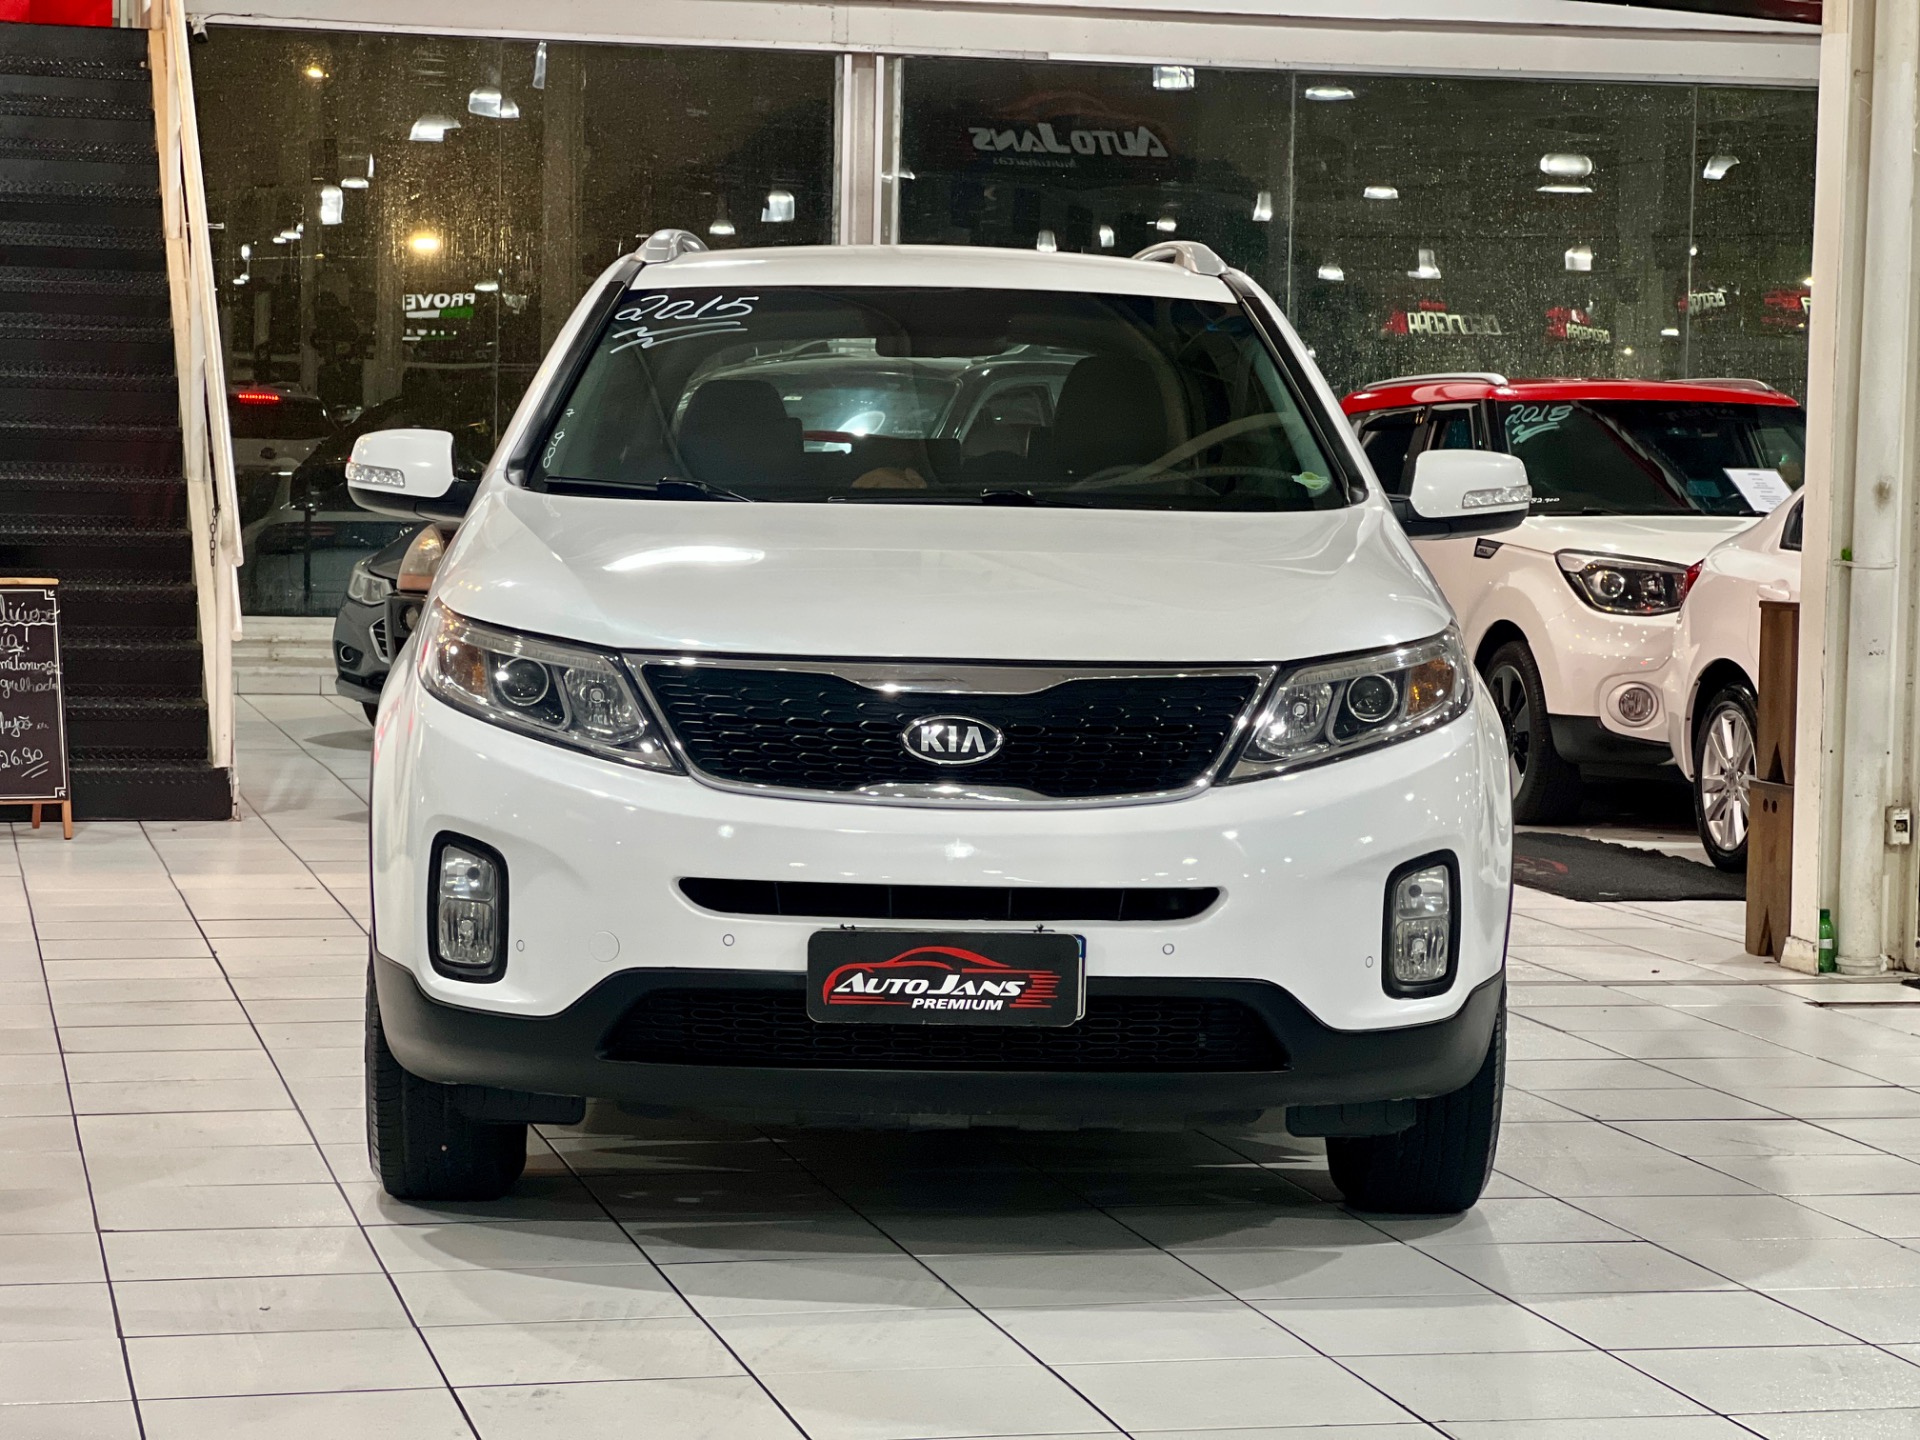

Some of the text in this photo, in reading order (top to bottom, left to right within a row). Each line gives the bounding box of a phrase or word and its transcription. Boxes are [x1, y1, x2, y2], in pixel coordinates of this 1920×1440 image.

[614, 294, 760, 321] 2015
[1505, 404, 1573, 425] 2018
[920, 725, 987, 753] KIA
[833, 972, 1026, 996] AUTO JANS
[911, 998, 1004, 1011] PREMIUM
